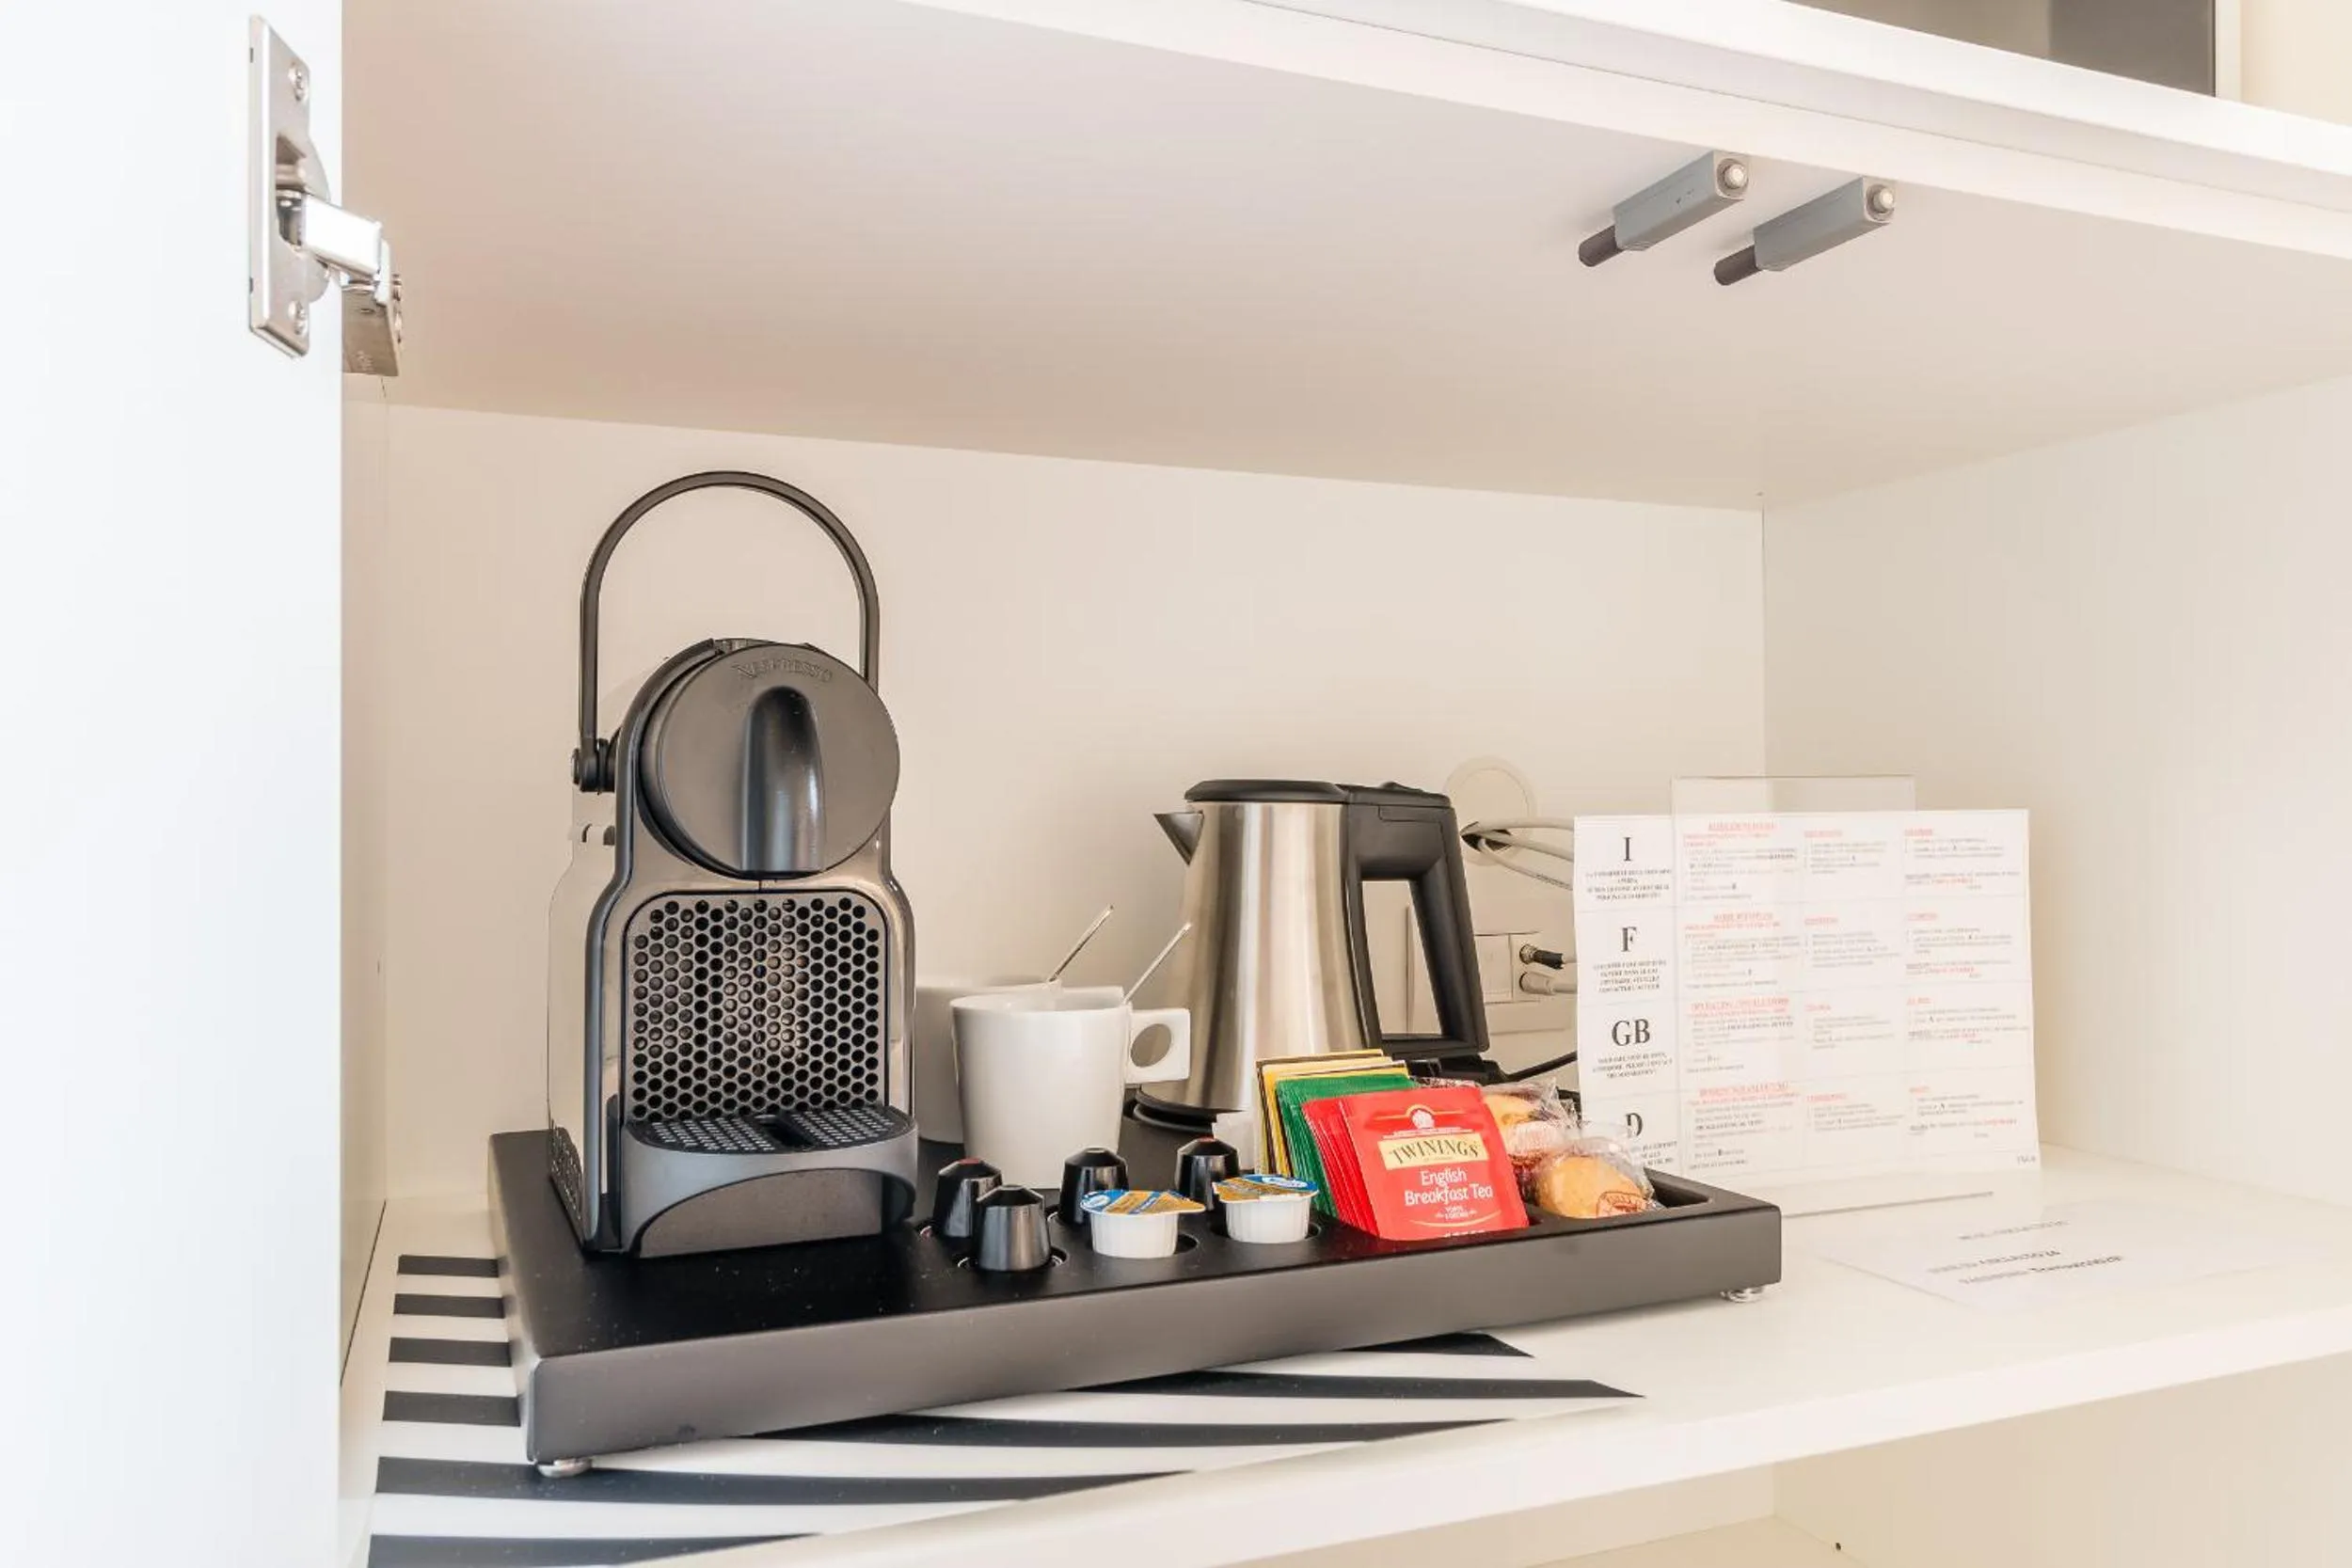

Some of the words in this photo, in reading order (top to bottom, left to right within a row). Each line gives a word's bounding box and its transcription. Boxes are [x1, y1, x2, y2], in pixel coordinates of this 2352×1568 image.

[1620, 926, 1639, 952] F
[1612, 1019, 1650, 1046] GB
[1389, 1139, 1480, 1164] TWININGS
[1421, 1168, 1467, 1187] English
[1405, 1185, 1470, 1206] Breakfast
[1470, 1183, 1493, 1198] Tea
